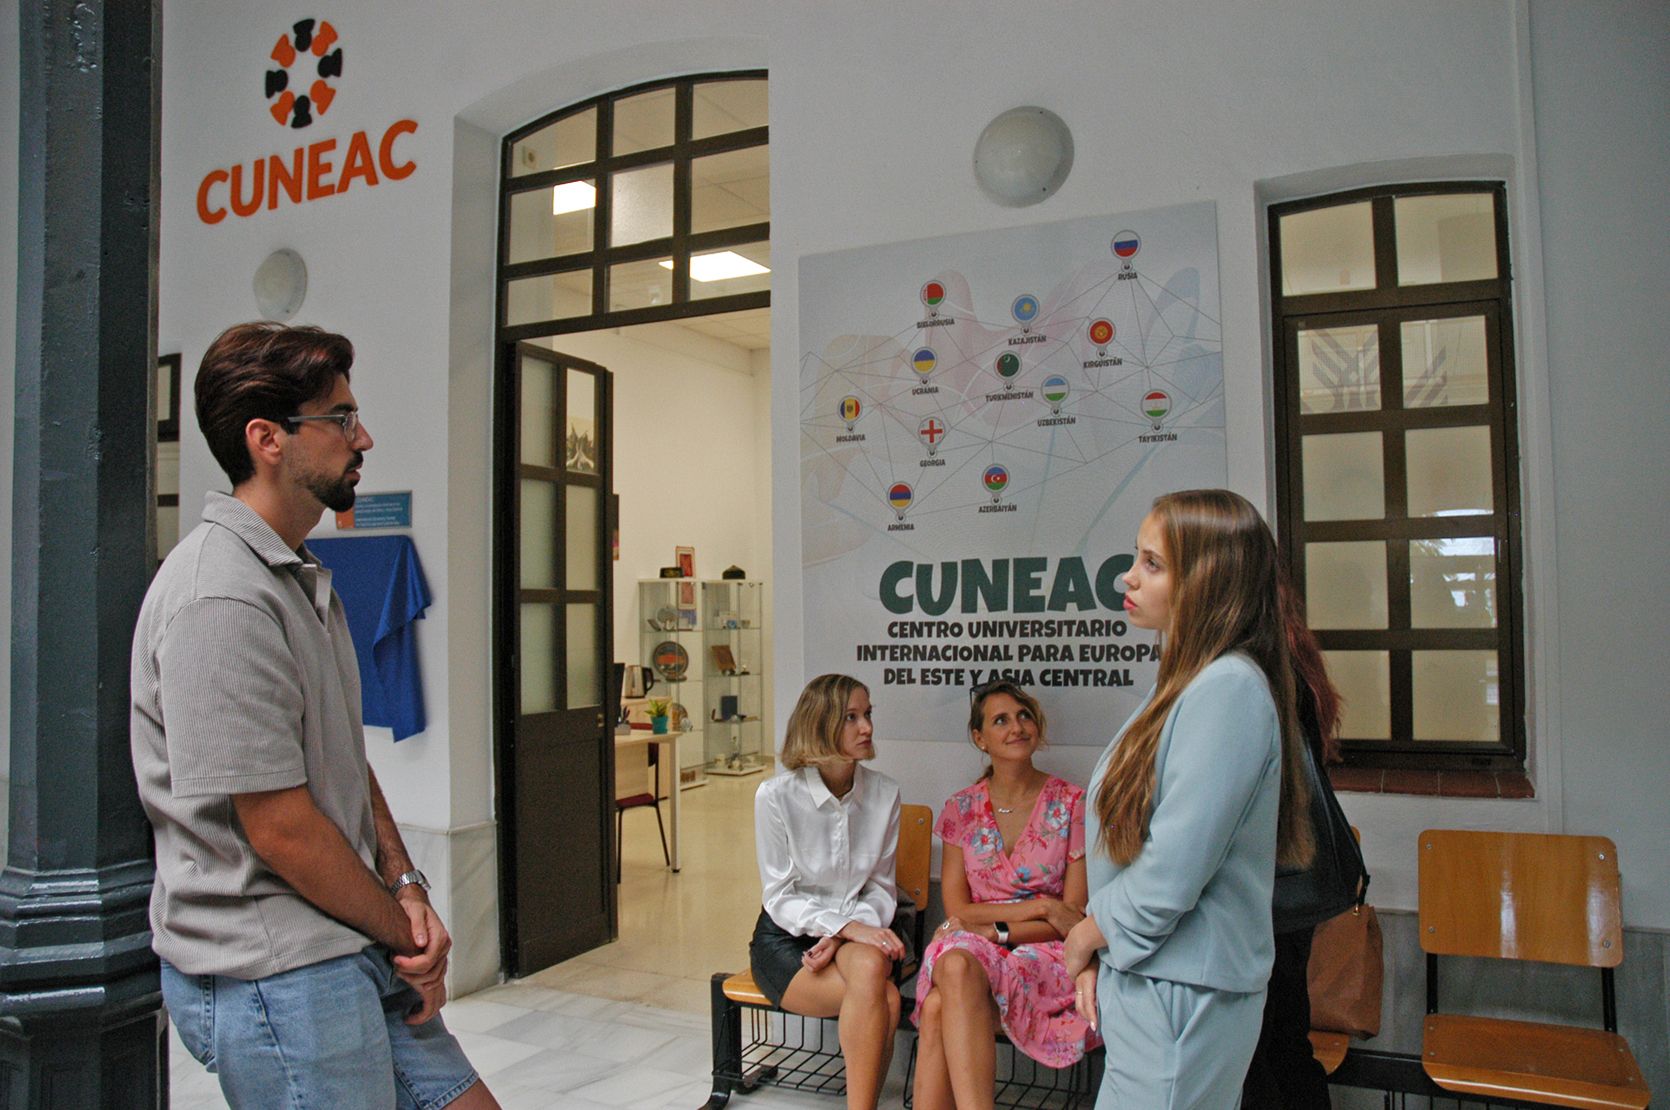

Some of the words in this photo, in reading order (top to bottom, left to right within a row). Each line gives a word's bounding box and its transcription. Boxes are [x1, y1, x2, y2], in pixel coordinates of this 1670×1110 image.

[197, 119, 418, 224] CUNEAC
[1118, 272, 1137, 281] RUSIA
[1008, 335, 1046, 346] KAZAJISTÁN
[912, 387, 939, 395] UCRANIA
[1037, 417, 1076, 427] UZBEKISTÁN
[836, 434, 866, 442] MOLDAVIA
[920, 459, 946, 467] GEORGIA
[978, 504, 1017, 513] AZERBAIYÁN
[887, 523, 914, 531] ARMENIA
[879, 554, 1135, 616] CUNEAC
[887, 621, 963, 638] CENTRO
[968, 619, 1127, 638] UNIVERSITARIO
[857, 644, 1013, 662] INTERNACIONAL
[1018, 644, 1072, 662] PARA
[1079, 643, 1161, 662] EUROPA
[884, 668, 916, 685] DEL
[920, 669, 965, 686] ESTE
[969, 669, 983, 687] Y
[988, 668, 1035, 687] ASIA
[1039, 669, 1134, 687] CENTRAL
